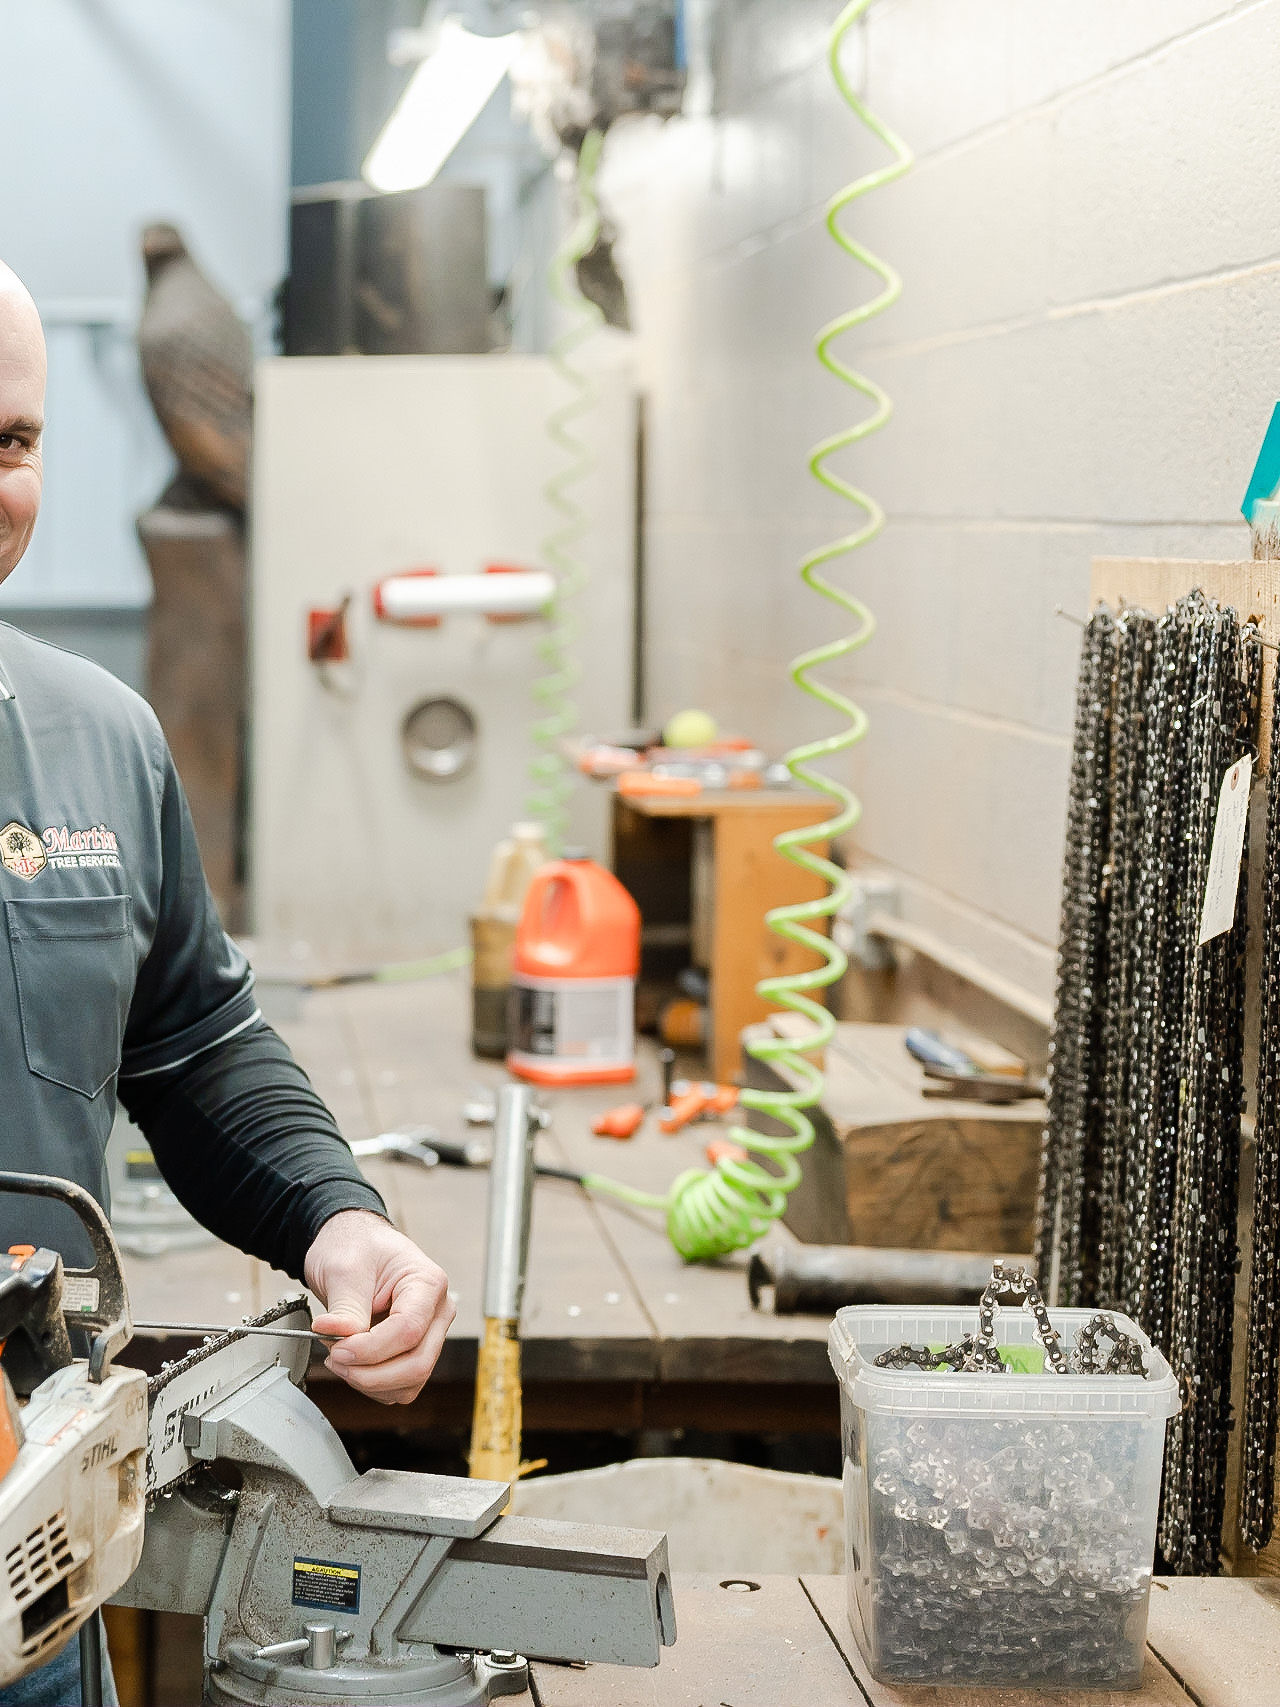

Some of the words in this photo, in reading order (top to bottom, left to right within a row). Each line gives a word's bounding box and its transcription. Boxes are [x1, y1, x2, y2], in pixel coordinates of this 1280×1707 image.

[42, 825, 118, 851] Martin
[13, 857, 38, 873] MTS
[48, 856, 79, 869] TREE
[315, 1567, 342, 1575] CAUTION
